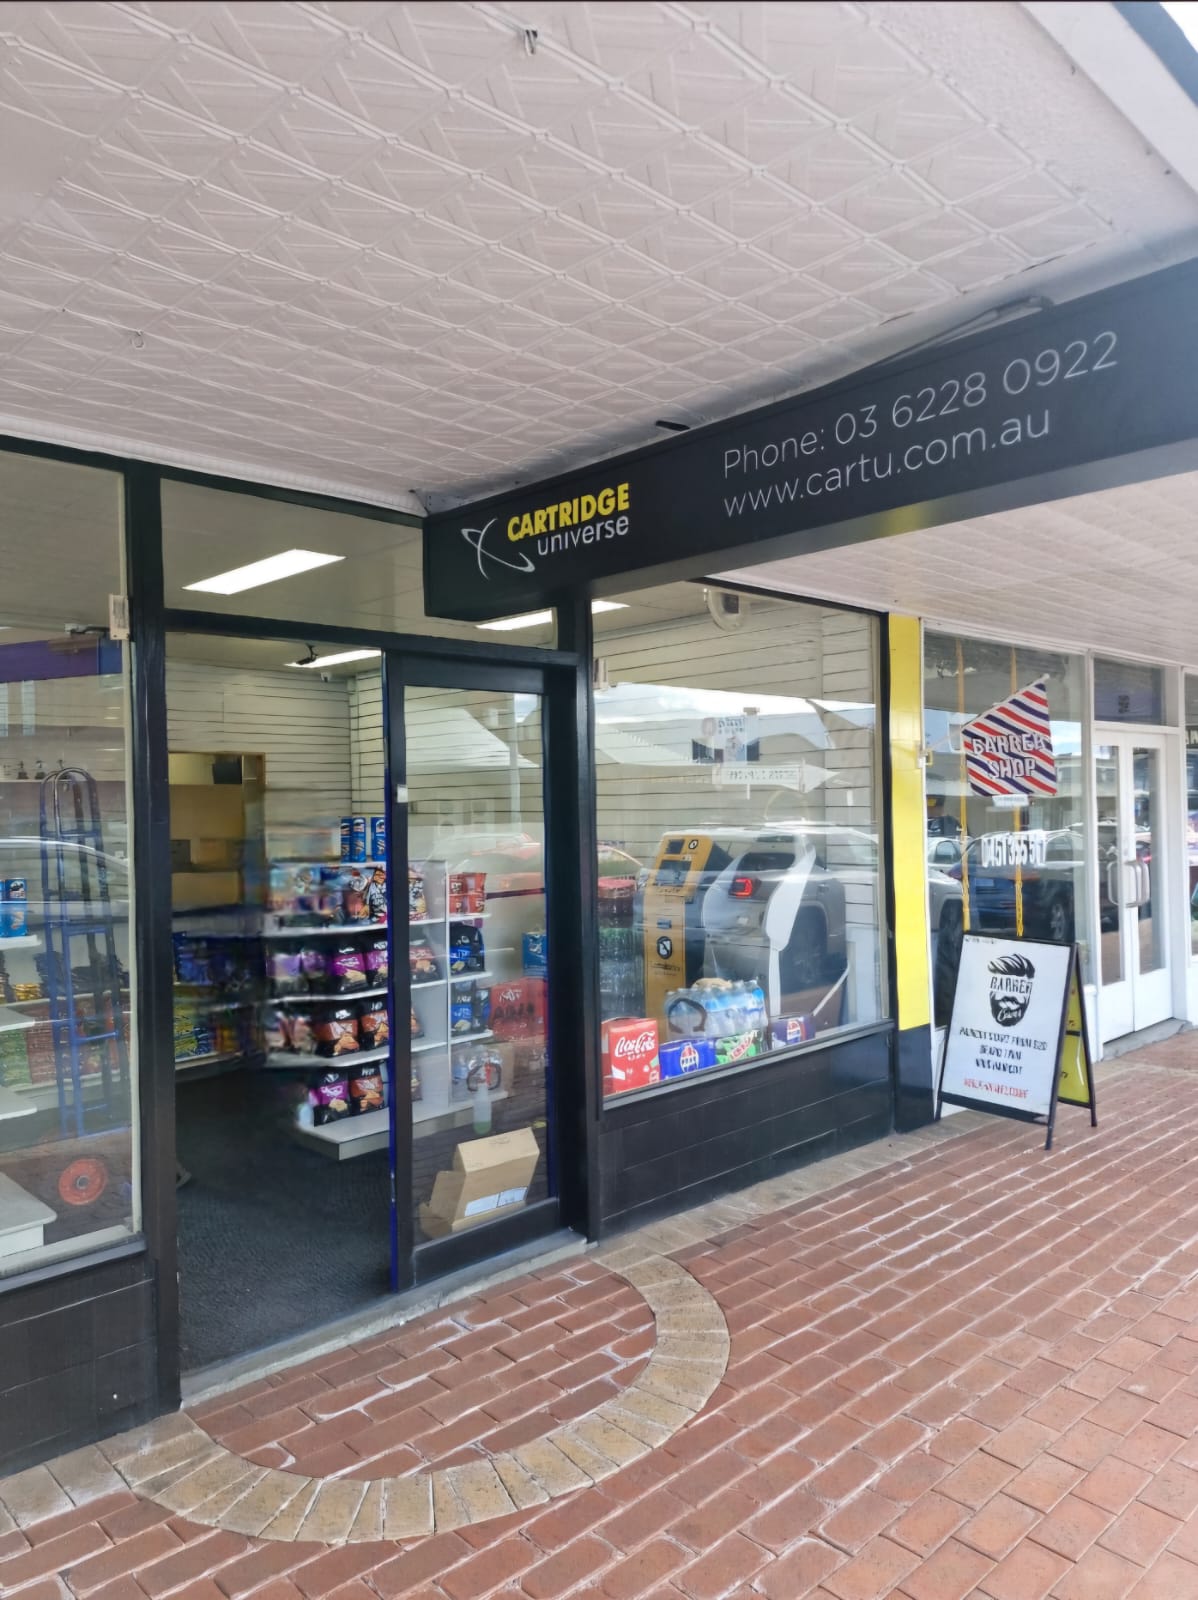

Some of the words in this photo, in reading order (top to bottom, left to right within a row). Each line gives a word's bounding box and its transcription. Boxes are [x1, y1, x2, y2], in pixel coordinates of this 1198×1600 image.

[724, 428, 824, 479] Phone:
[835, 404, 878, 445] 03
[892, 371, 987, 428] 6228
[1003, 331, 1118, 395] 0922
[724, 409, 1049, 517] www.cartu.com.au
[507, 482, 630, 542] CARTRIDGE
[537, 515, 630, 556] universe
[987, 756, 1037, 779] SHOP
